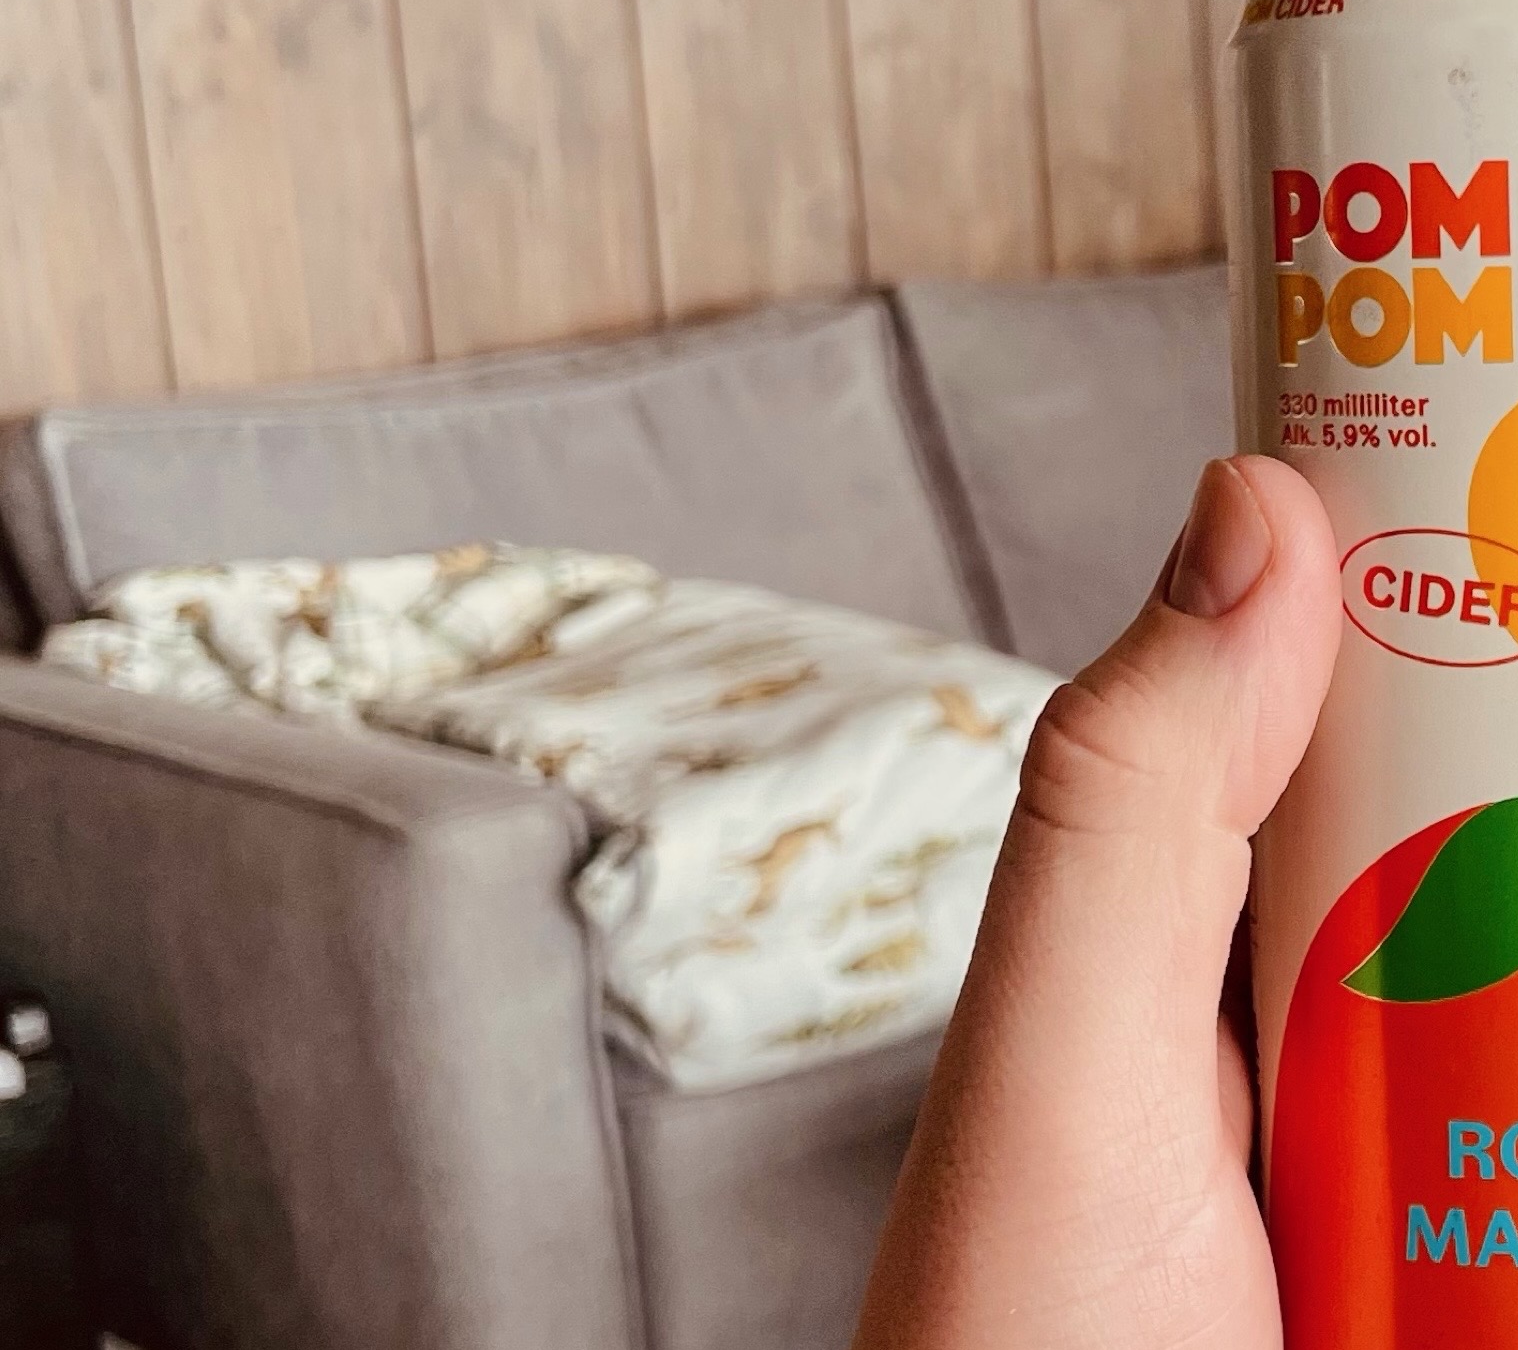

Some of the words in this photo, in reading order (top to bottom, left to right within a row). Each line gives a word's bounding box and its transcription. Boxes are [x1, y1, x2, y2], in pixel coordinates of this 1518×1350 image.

[1272, 160, 1511, 263] POM
[1277, 266, 1514, 368] POM
[1279, 392, 1318, 418] 330
[1323, 392, 1430, 418] milliliter
[1280, 423, 1317, 447] Alk.
[1322, 423, 1381, 450] 5,9%
[1387, 424, 1437, 448] vol.
